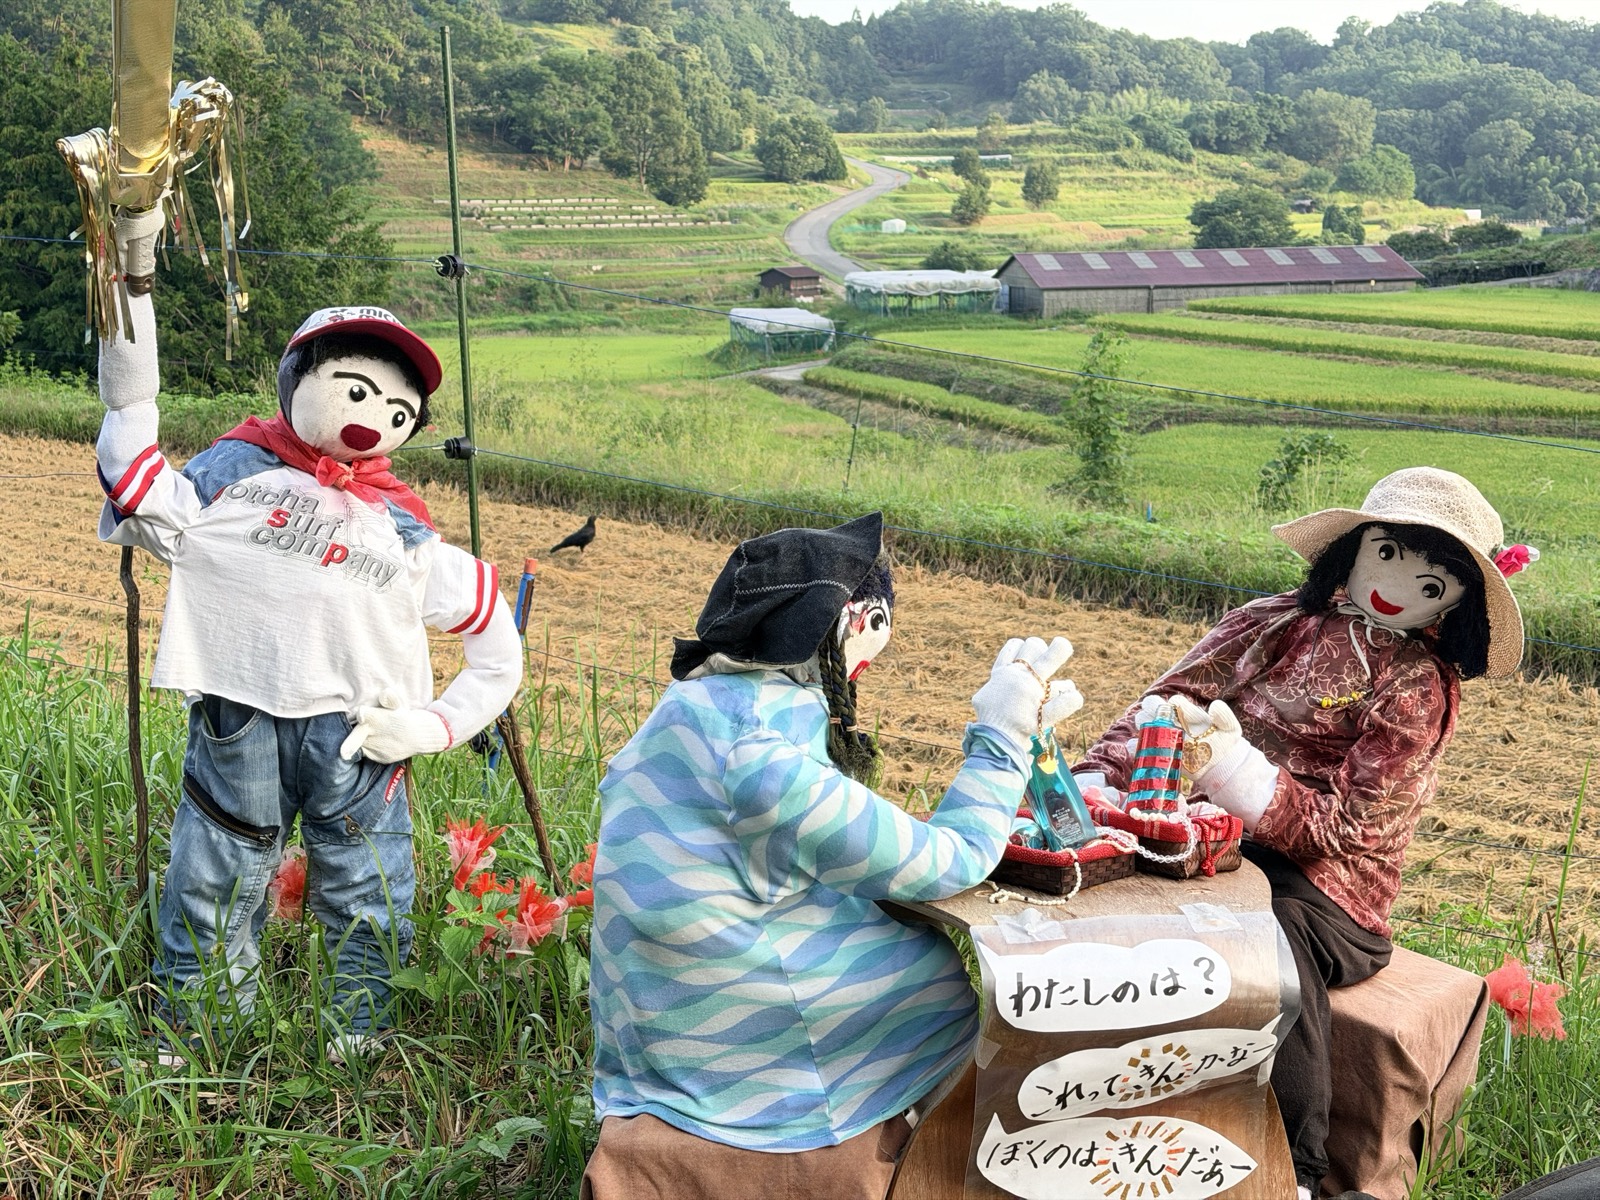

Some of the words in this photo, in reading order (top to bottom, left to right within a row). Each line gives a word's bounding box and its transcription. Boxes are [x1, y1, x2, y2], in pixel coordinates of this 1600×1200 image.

[211, 483, 320, 515] otcha
[267, 508, 344, 540] surf
[251, 526, 399, 588] company
[1009, 957, 1216, 1018] わたしのは？
